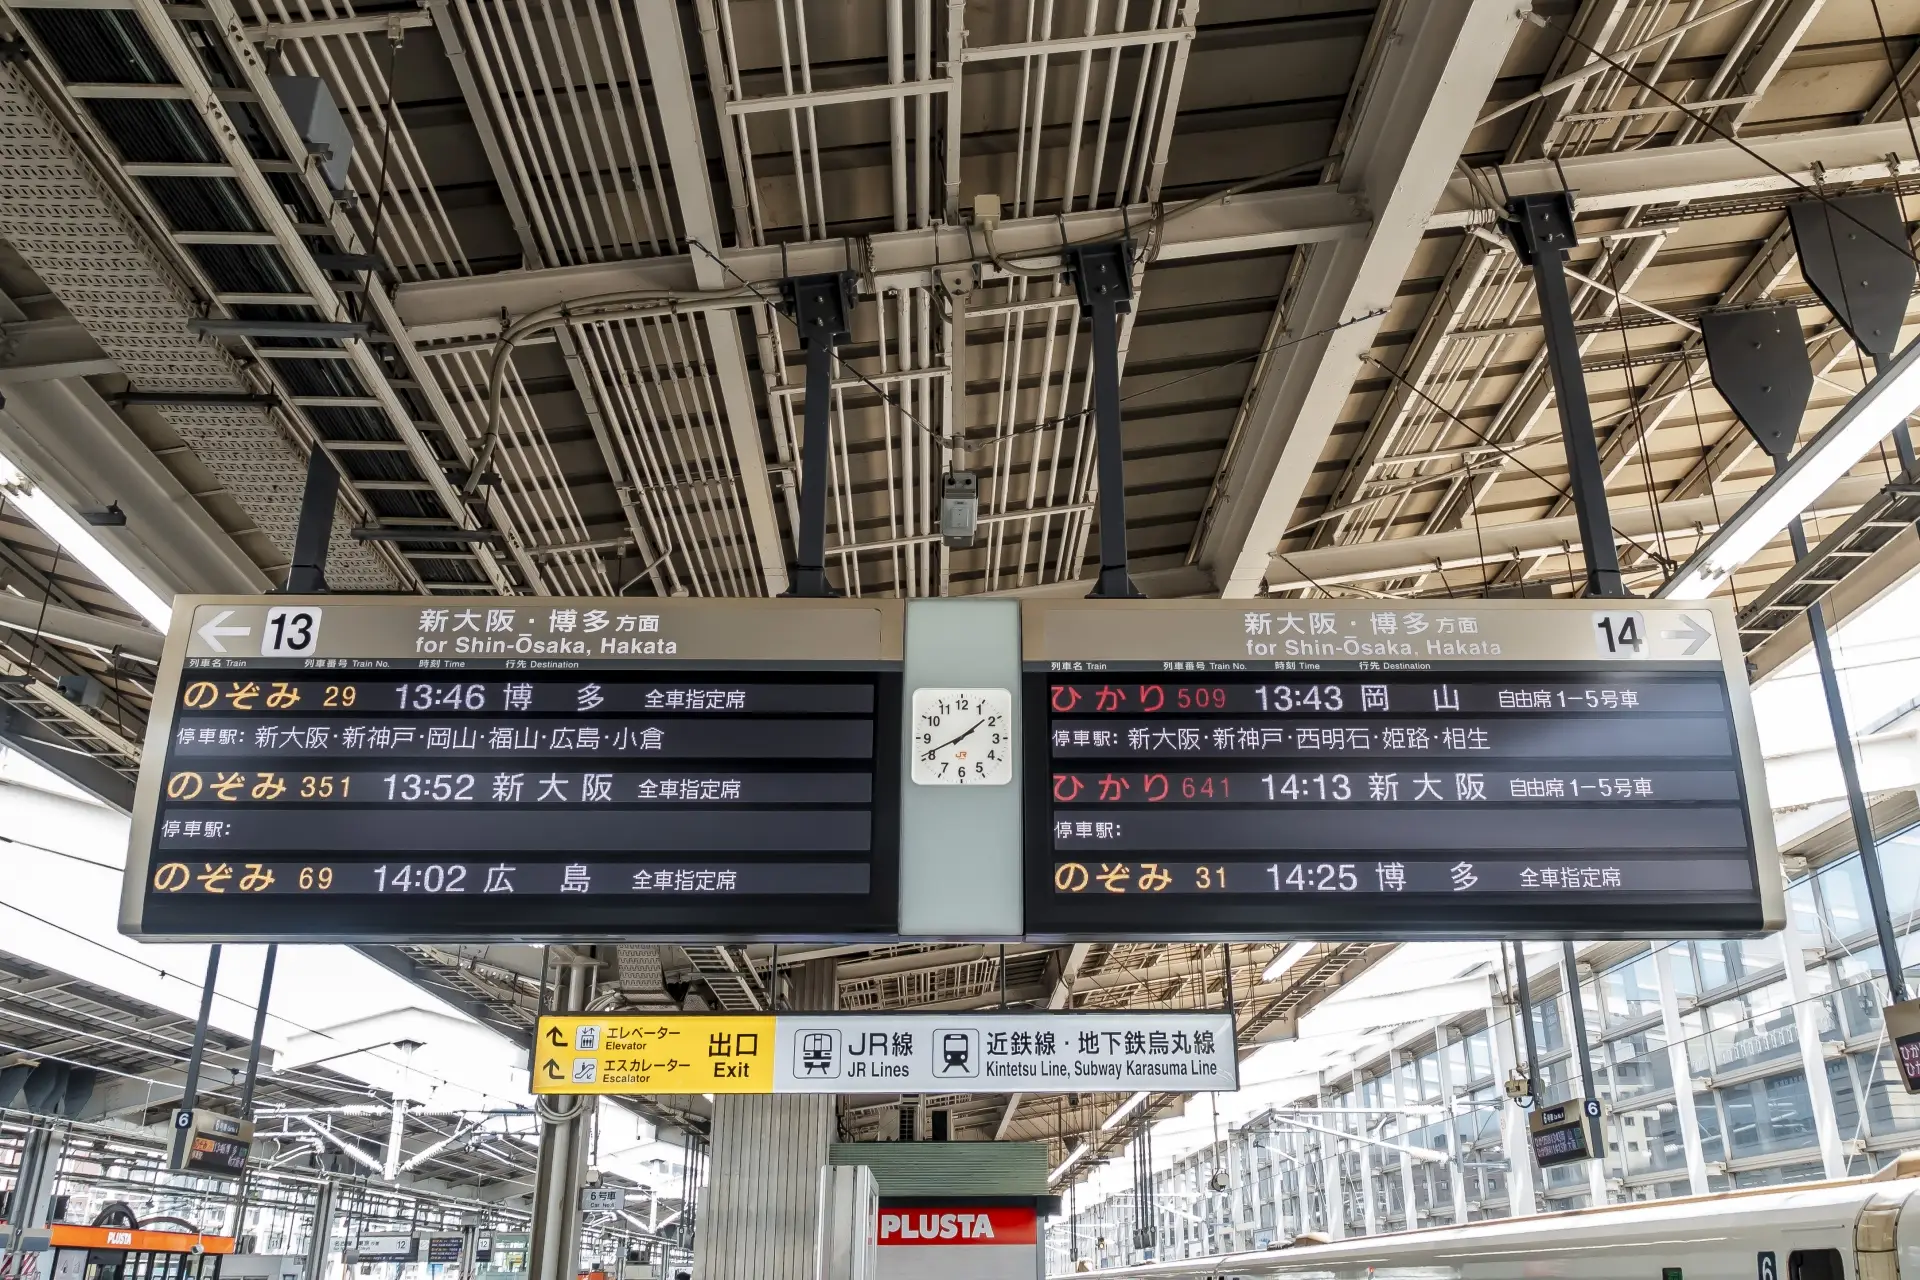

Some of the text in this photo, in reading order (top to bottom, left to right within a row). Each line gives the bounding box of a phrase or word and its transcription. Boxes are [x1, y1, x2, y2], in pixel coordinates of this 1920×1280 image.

[270, 613, 313, 650] 13
[1597, 616, 1643, 653] 14
[415, 633, 678, 657] for Shin-Ōsaka, Hakata
[1246, 639, 1277, 656] for
[1426, 640, 1501, 656] Hakata
[189, 658, 247, 669] 列車名 Train
[304, 658, 390, 669] 列車番号 Train No.
[418, 659, 466, 669] 時刻 Time
[505, 659, 579, 669] 行先 Destination
[1051, 661, 1107, 671] 列車名 Train
[1163, 661, 1247, 671] 列車番号 Train No.
[1274, 661, 1321, 671] 時刻 Time
[1359, 661, 1431, 671] 行先 Destination
[183, 681, 301, 710] のぞみ
[323, 685, 357, 707] 29
[395, 683, 486, 710] 13:46
[644, 688, 746, 710] 全車指定席
[1051, 685, 1165, 712] ひかり
[1177, 688, 1227, 709] 509
[1254, 685, 1344, 711] 13:43
[939, 704, 950, 715] 11
[955, 699, 969, 711] 12
[976, 704, 982, 715] 1
[927, 715, 941, 727] 10
[987, 716, 996, 727] 2
[923, 733, 932, 744] 9
[992, 733, 1000, 744] 3
[928, 749, 936, 761] 8
[987, 749, 996, 760] 4
[941, 762, 949, 773] 7
[958, 766, 966, 778] 6
[975, 762, 984, 773] 5
[167, 771, 287, 801] のぞみ
[300, 776, 351, 798] 351
[384, 773, 476, 801] 13:52
[638, 778, 742, 800] 全車指定席
[1053, 773, 1169, 801] ひかり
[1182, 777, 1230, 799] 641
[1262, 773, 1352, 801] 14:13
[154, 862, 276, 893] のぞみ
[299, 867, 333, 890] 69
[374, 864, 468, 893] 14:02
[632, 869, 737, 892] 全車指定席
[1054, 862, 1173, 894] のぞみ
[1196, 866, 1227, 889] 31
[1266, 863, 1358, 892] 14:25
[1519, 866, 1622, 889] 全車指定席
[606, 1027, 681, 1040] エレベーター
[605, 1041, 647, 1051] Elevator
[708, 1032, 758, 1058] 出口
[847, 1032, 914, 1057] JR線
[1899, 1042, 1920, 1060] ひか
[603, 1058, 691, 1072] エスカレーター
[713, 1062, 750, 1078] Exit
[848, 1062, 910, 1078] JR Lines
[986, 1059, 1217, 1080] Kintetsu Line, Subway Karasuma Line
[602, 1074, 651, 1083] Escalator
[1587, 1102, 1599, 1116] 6
[178, 1112, 190, 1127] 6
[880, 1213, 995, 1239] PLUSTA
[107, 1231, 132, 1245] PLUSTA
[480, 1240, 488, 1248] 12
[396, 1240, 406, 1249] 12
[1762, 1256, 1773, 1280] 6
